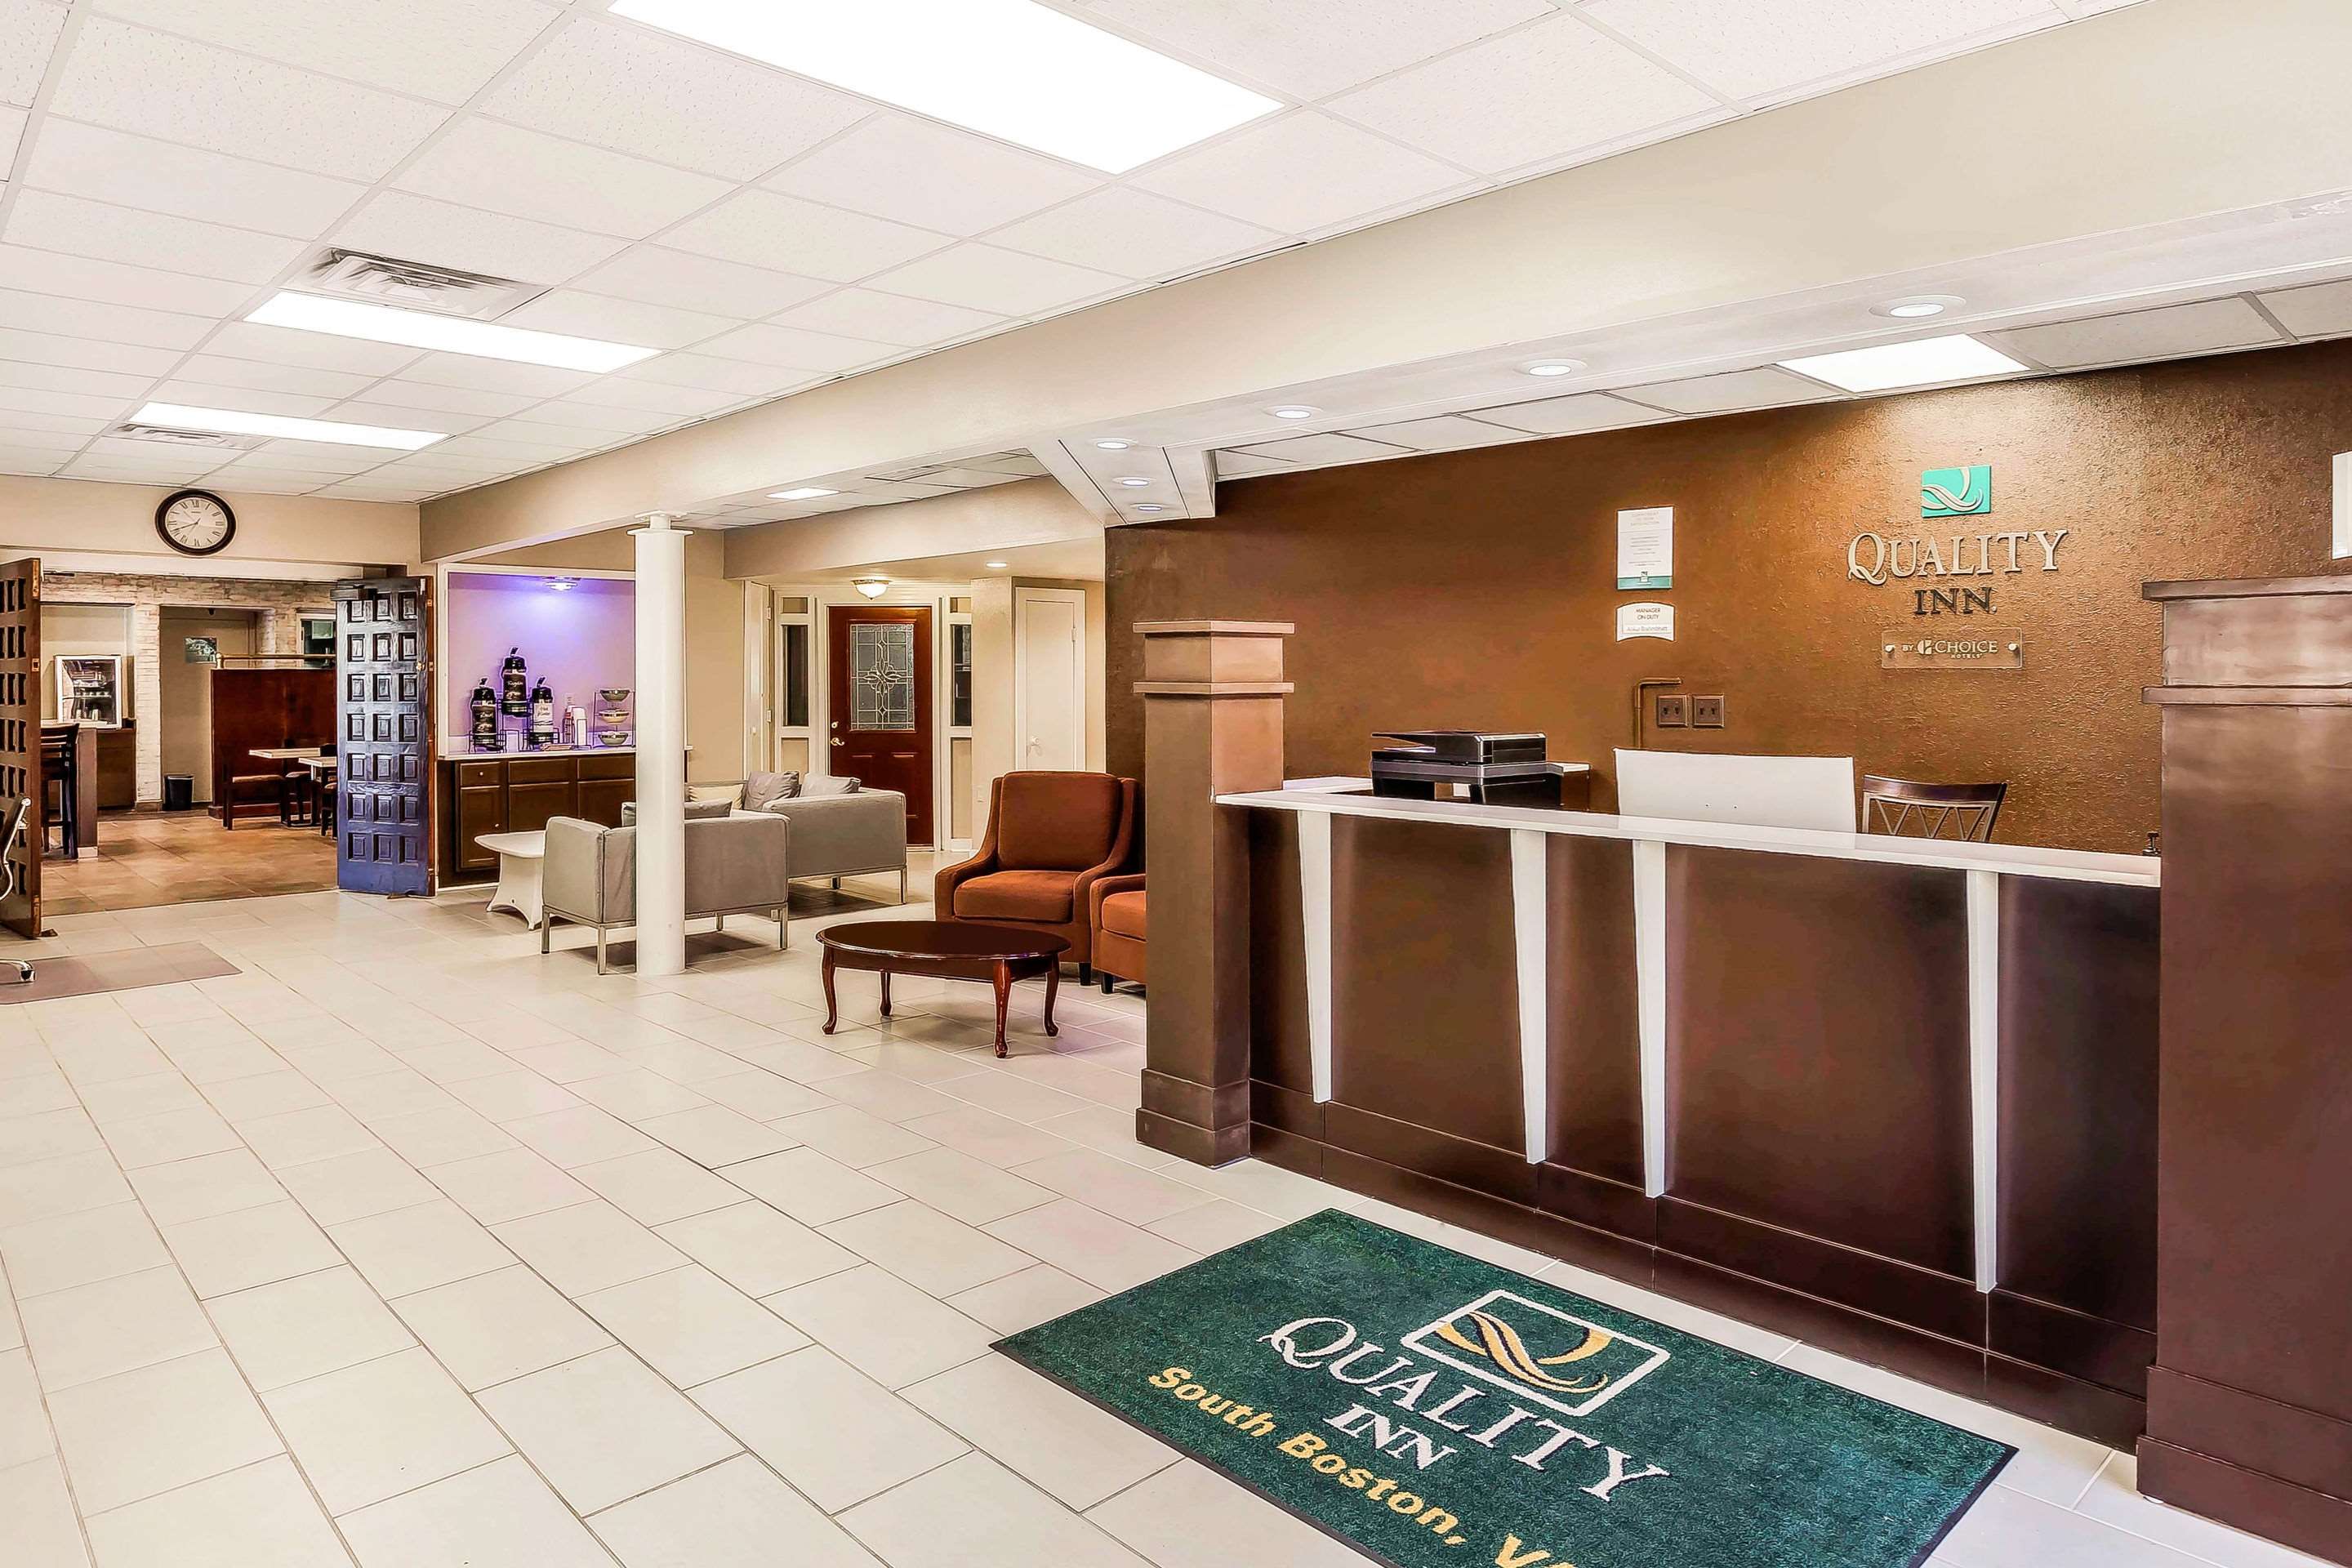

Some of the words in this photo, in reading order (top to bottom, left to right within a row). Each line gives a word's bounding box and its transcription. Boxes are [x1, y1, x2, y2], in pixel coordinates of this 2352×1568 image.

[1847, 530, 2069, 586] QUALITY
[1935, 640, 1998, 654] CHOICE
[1256, 1317, 1672, 1503] QUALITY
[1322, 1403, 1459, 1471] INN
[1148, 1365, 1277, 1438] South
[1276, 1432, 1468, 1547] Boston,
[1494, 1532, 1579, 1568] V
